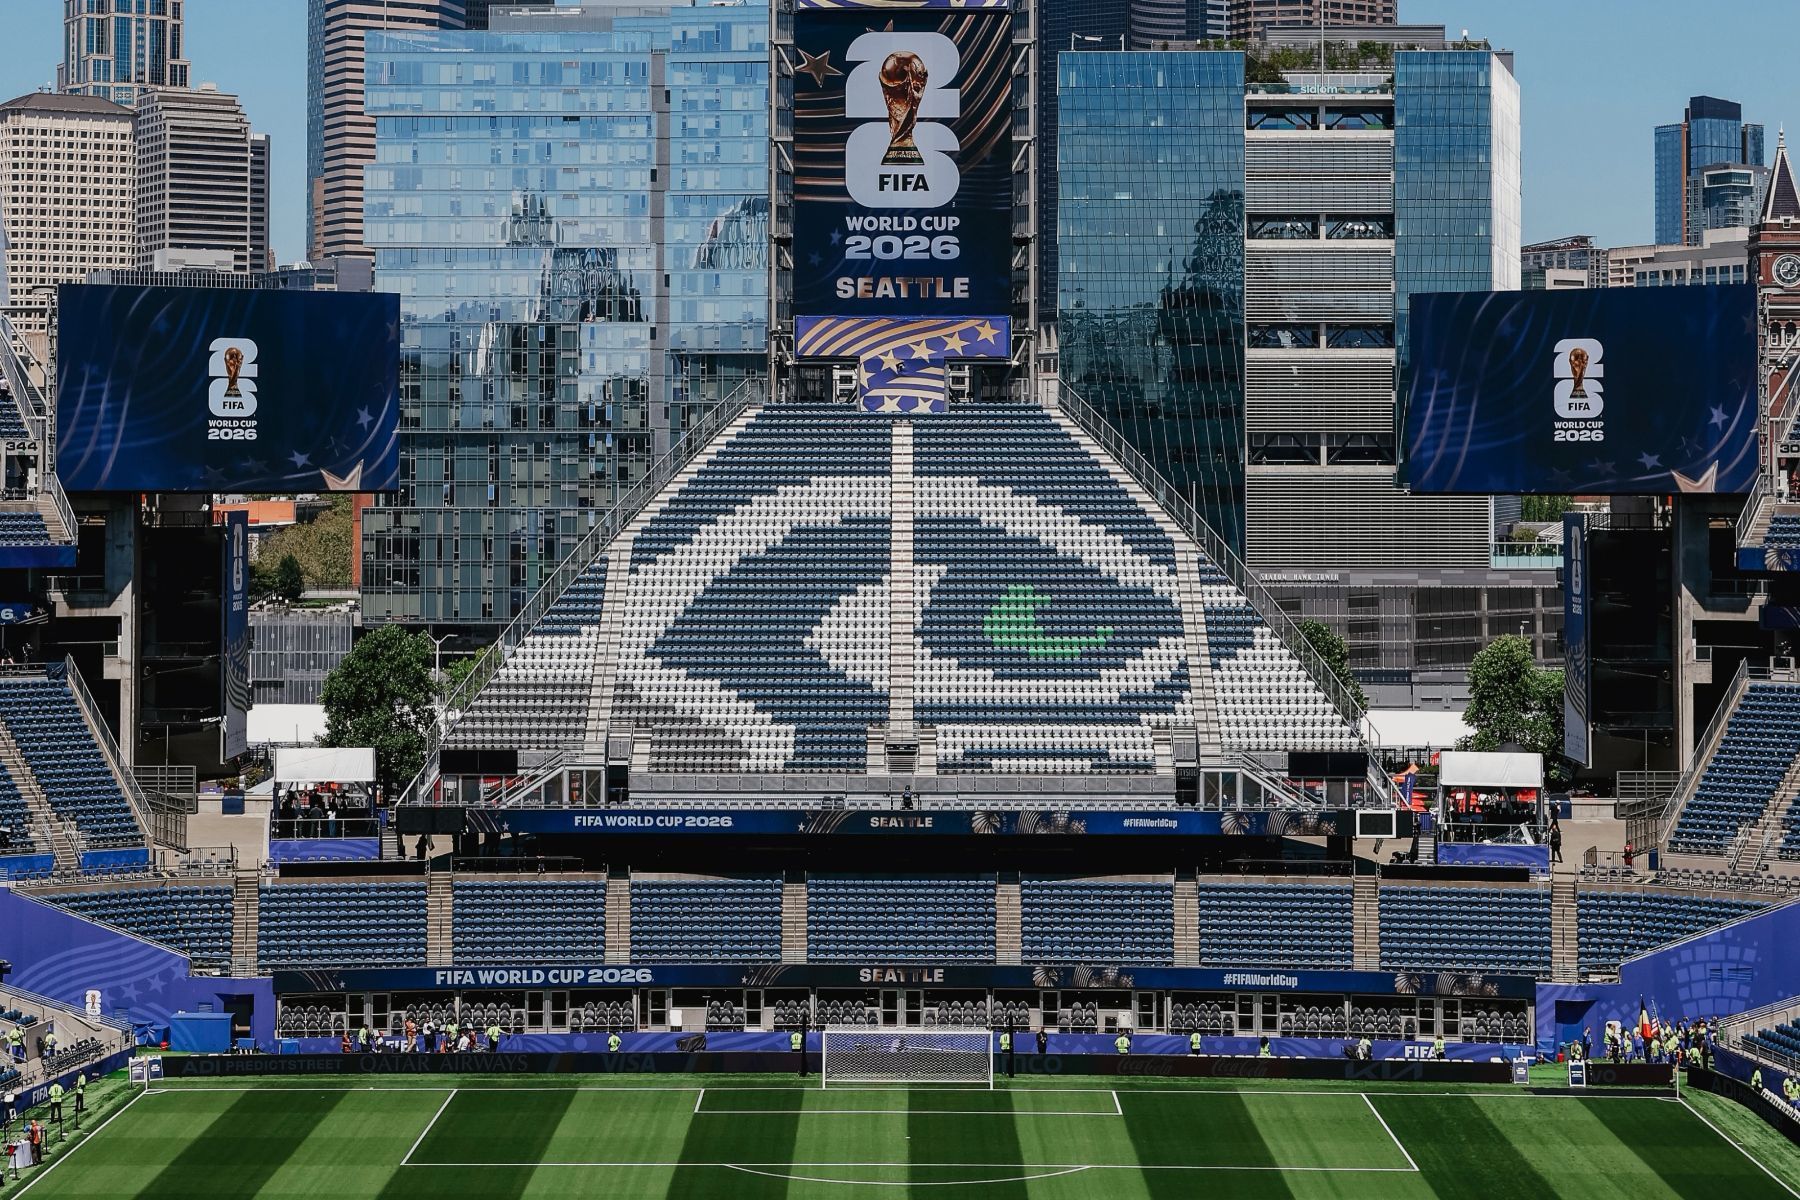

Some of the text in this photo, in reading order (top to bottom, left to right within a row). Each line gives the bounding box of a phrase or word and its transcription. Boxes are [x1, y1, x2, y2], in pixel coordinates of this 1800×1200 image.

[878, 174, 930, 191] FIFA
[845, 216, 960, 231] WORLD CUP
[845, 235, 960, 260] 2026
[836, 276, 970, 298] SEATTLE
[222, 401, 245, 410] FIFA
[1568, 402, 1591, 411] FIFA
[208, 419, 257, 428] WORLD CUP
[1554, 421, 1604, 429] WORLD CUP
[208, 428, 257, 440] 2026
[1554, 429, 1604, 442] 2026
[6, 441, 38, 451] 344
[1293, 573, 1312, 581] HAWK
[1317, 573, 1339, 581] TOWER
[574, 815, 732, 827] FIFA WORLD CUP 2026
[870, 816, 933, 828] SEATTLE
[1123, 818, 1178, 829] #FIFAWorldCup
[436, 968, 653, 985] FIFA WORLD CUP 2026
[859, 968, 944, 983] SEATTLE
[1223, 973, 1298, 988] #FIFAWorldCup
[1404, 1045, 1438, 1058] FIFA
[225, 1058, 343, 1072] PREDICTSTREET
[359, 1054, 529, 1073] QATAR AIRWAYS
[601, 1054, 657, 1072] VISA
[32, 1086, 49, 1104] FIFA
